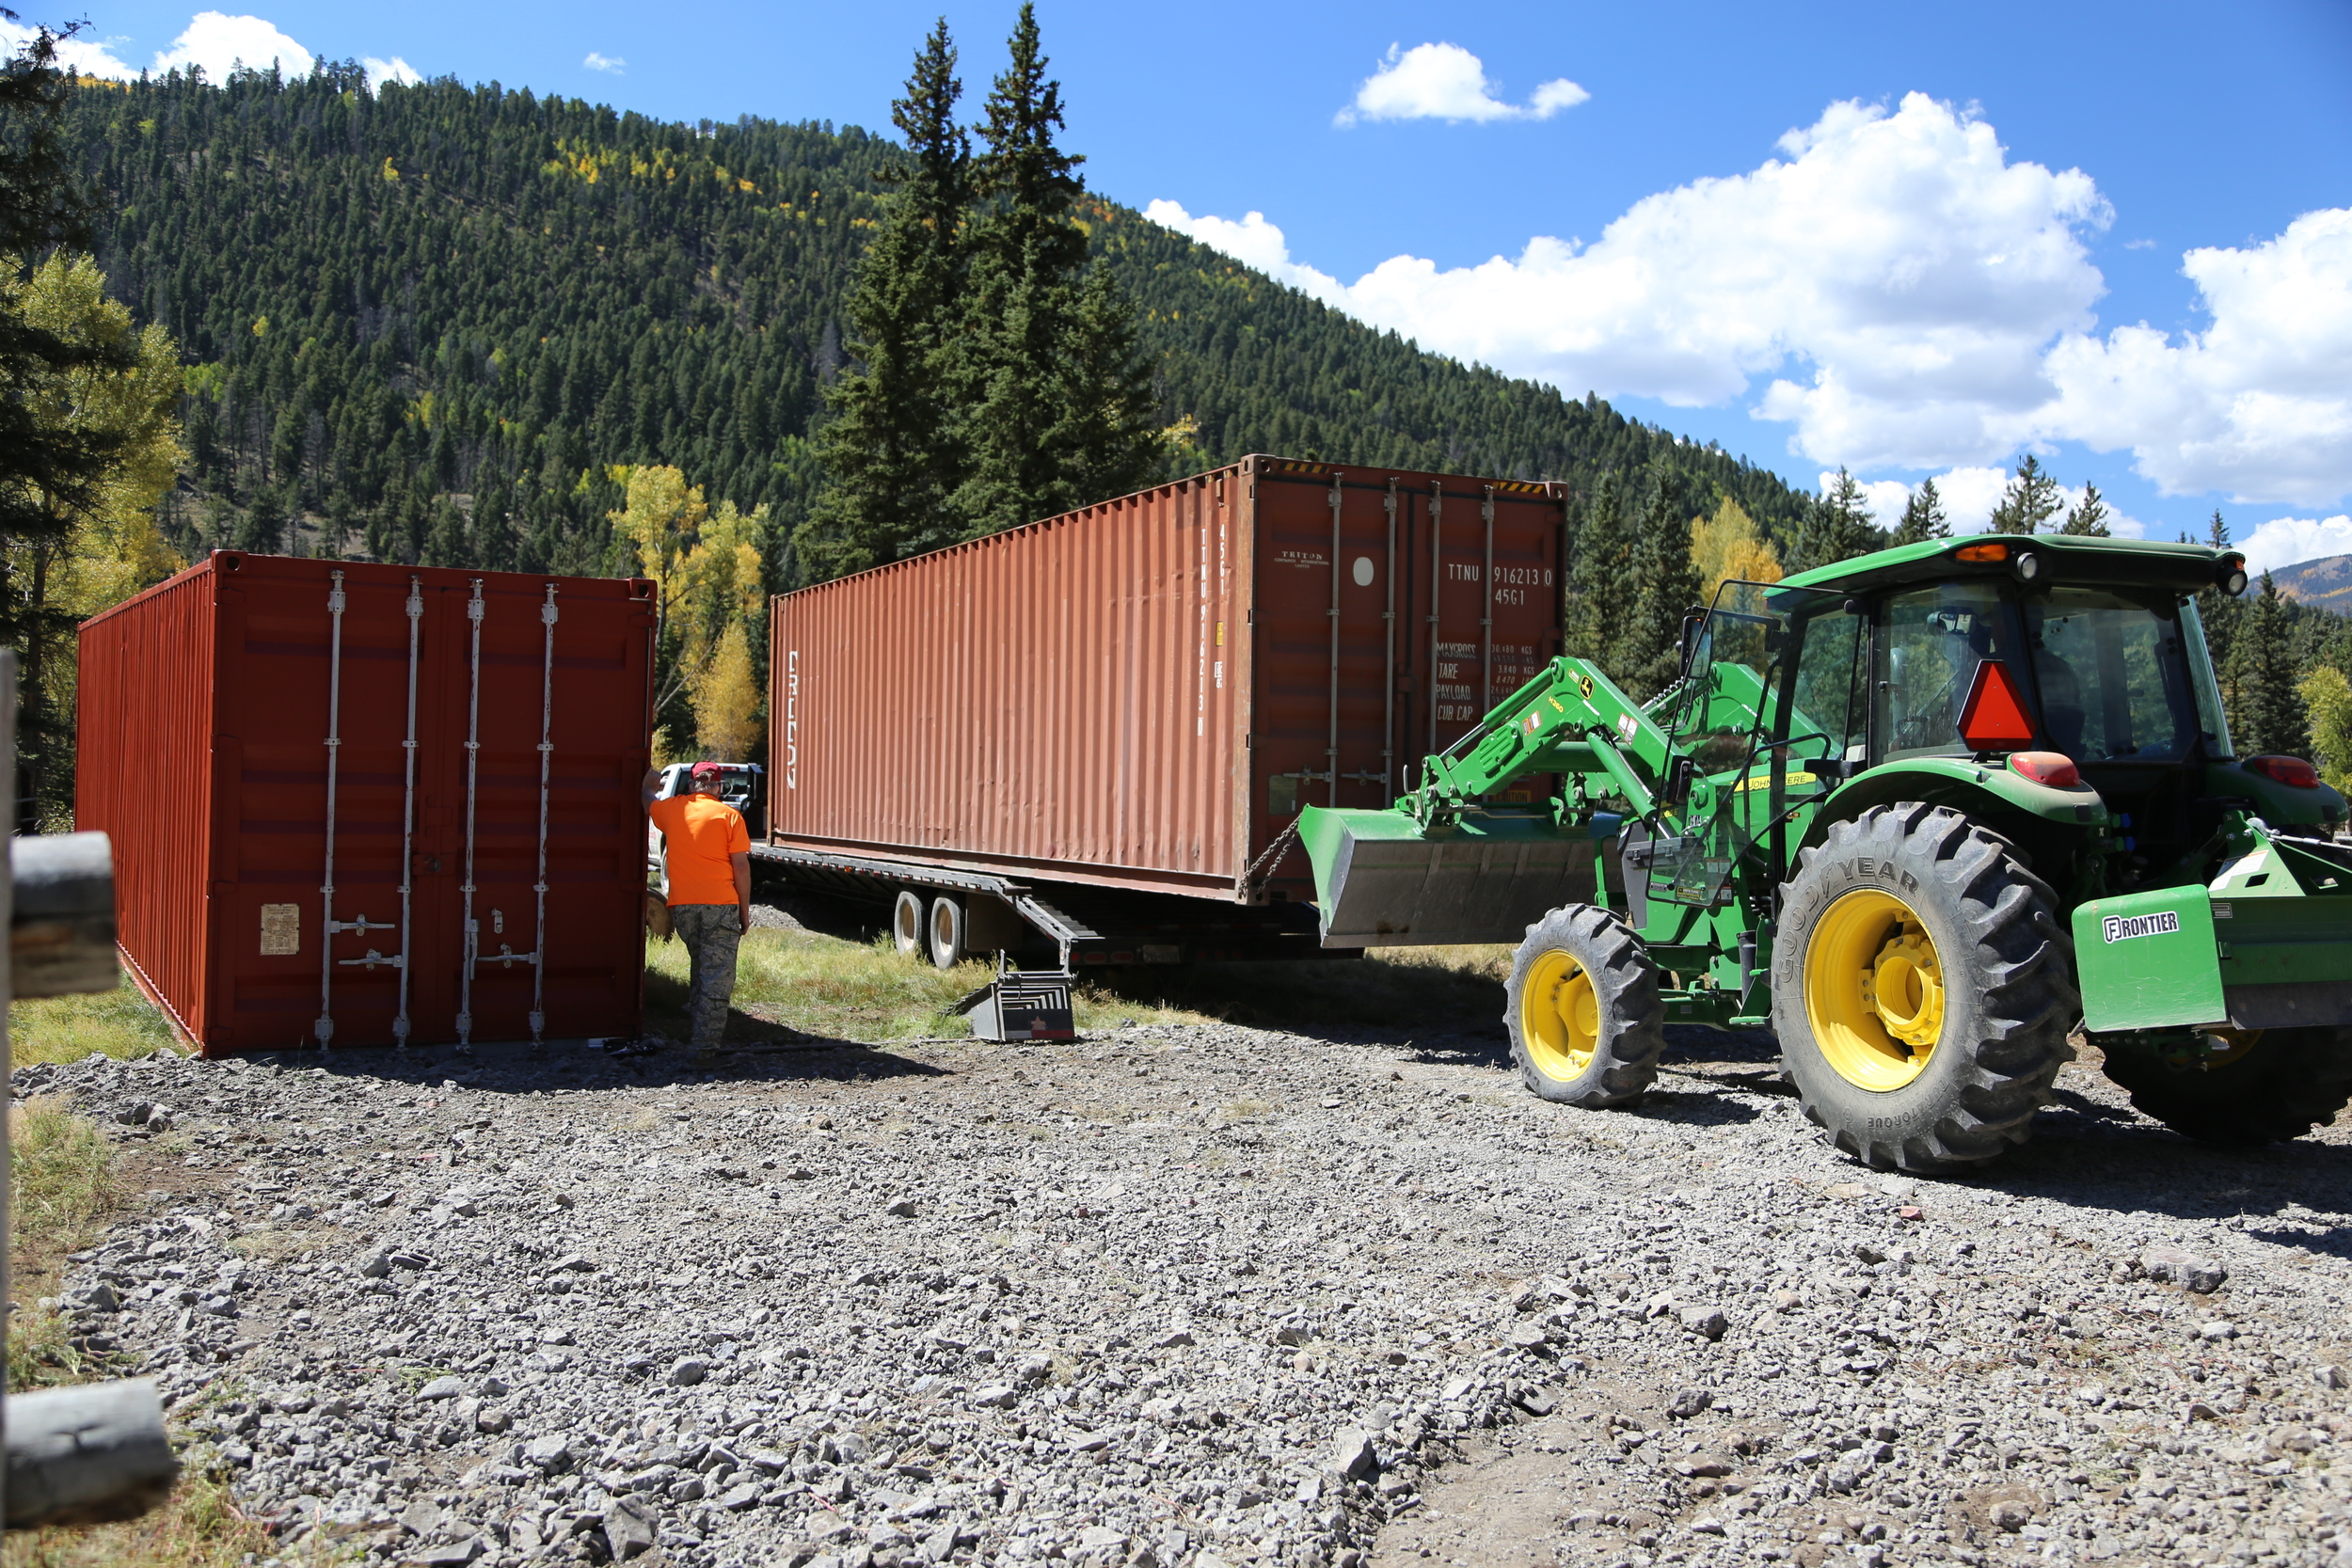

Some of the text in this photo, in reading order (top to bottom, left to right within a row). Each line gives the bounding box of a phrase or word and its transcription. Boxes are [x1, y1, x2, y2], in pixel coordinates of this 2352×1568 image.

[1281, 550, 1323, 560] TRITON
[1449, 563, 1551, 586] TTNU 916213 0
[1495, 589, 1524, 606] 45G1
[1437, 642, 1476, 658] MAXGROSS
[1521, 646, 1533, 655] KGS
[1438, 663, 1534, 679] TARE 3.840 KGS
[1496, 675, 1516, 685] 8.470
[1436, 684, 1471, 701] PAYLOAD
[1438, 705, 1473, 721] CUB. CAP.
[1548, 696, 1564, 713] H260
[1197, 717, 1203, 736] 0
[1786, 774, 1806, 784] ERE
[1780, 855, 1919, 983] GOODYEAR
[2104, 912, 2178, 942] FRONTIER
